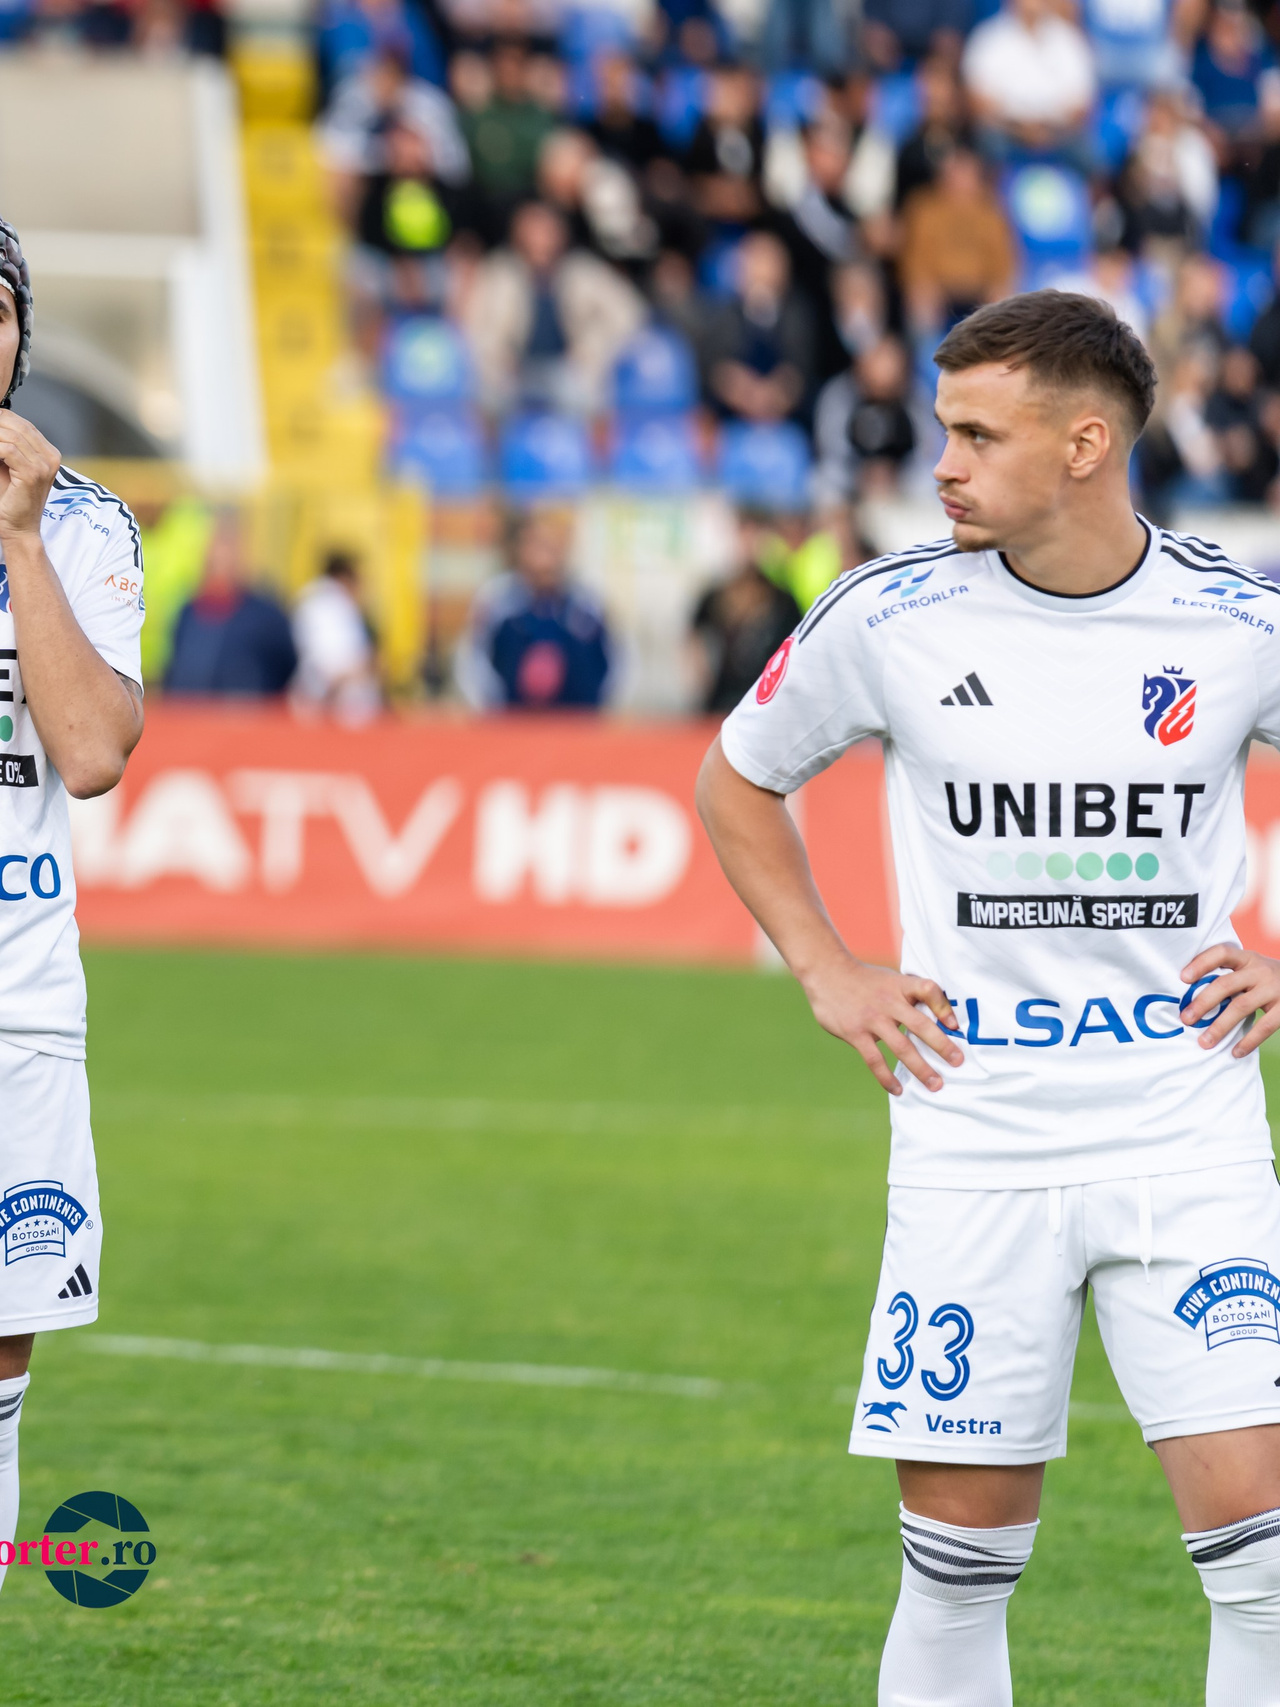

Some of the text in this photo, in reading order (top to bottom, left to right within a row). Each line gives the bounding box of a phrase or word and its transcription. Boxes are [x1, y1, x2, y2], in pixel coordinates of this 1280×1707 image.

[867, 585, 969, 628] ELECTROALFA
[1172, 597, 1274, 635] ELECTROALFA
[5, 761, 25, 784] 0%
[944, 781, 1206, 838] UNIBET
[470, 778, 693, 910] HD
[969, 895, 1186, 926] ÎMPREUNĂ SPRE 0%
[10, 1194, 82, 1226] CONTINENTS
[25, 1244, 49, 1252] GROUP
[1181, 1272, 1280, 1320] FIVE CONTINEN
[877, 1291, 974, 1401] 33
[1230, 1328, 1258, 1337] GROUP
[926, 1413, 1002, 1435] Vestra
